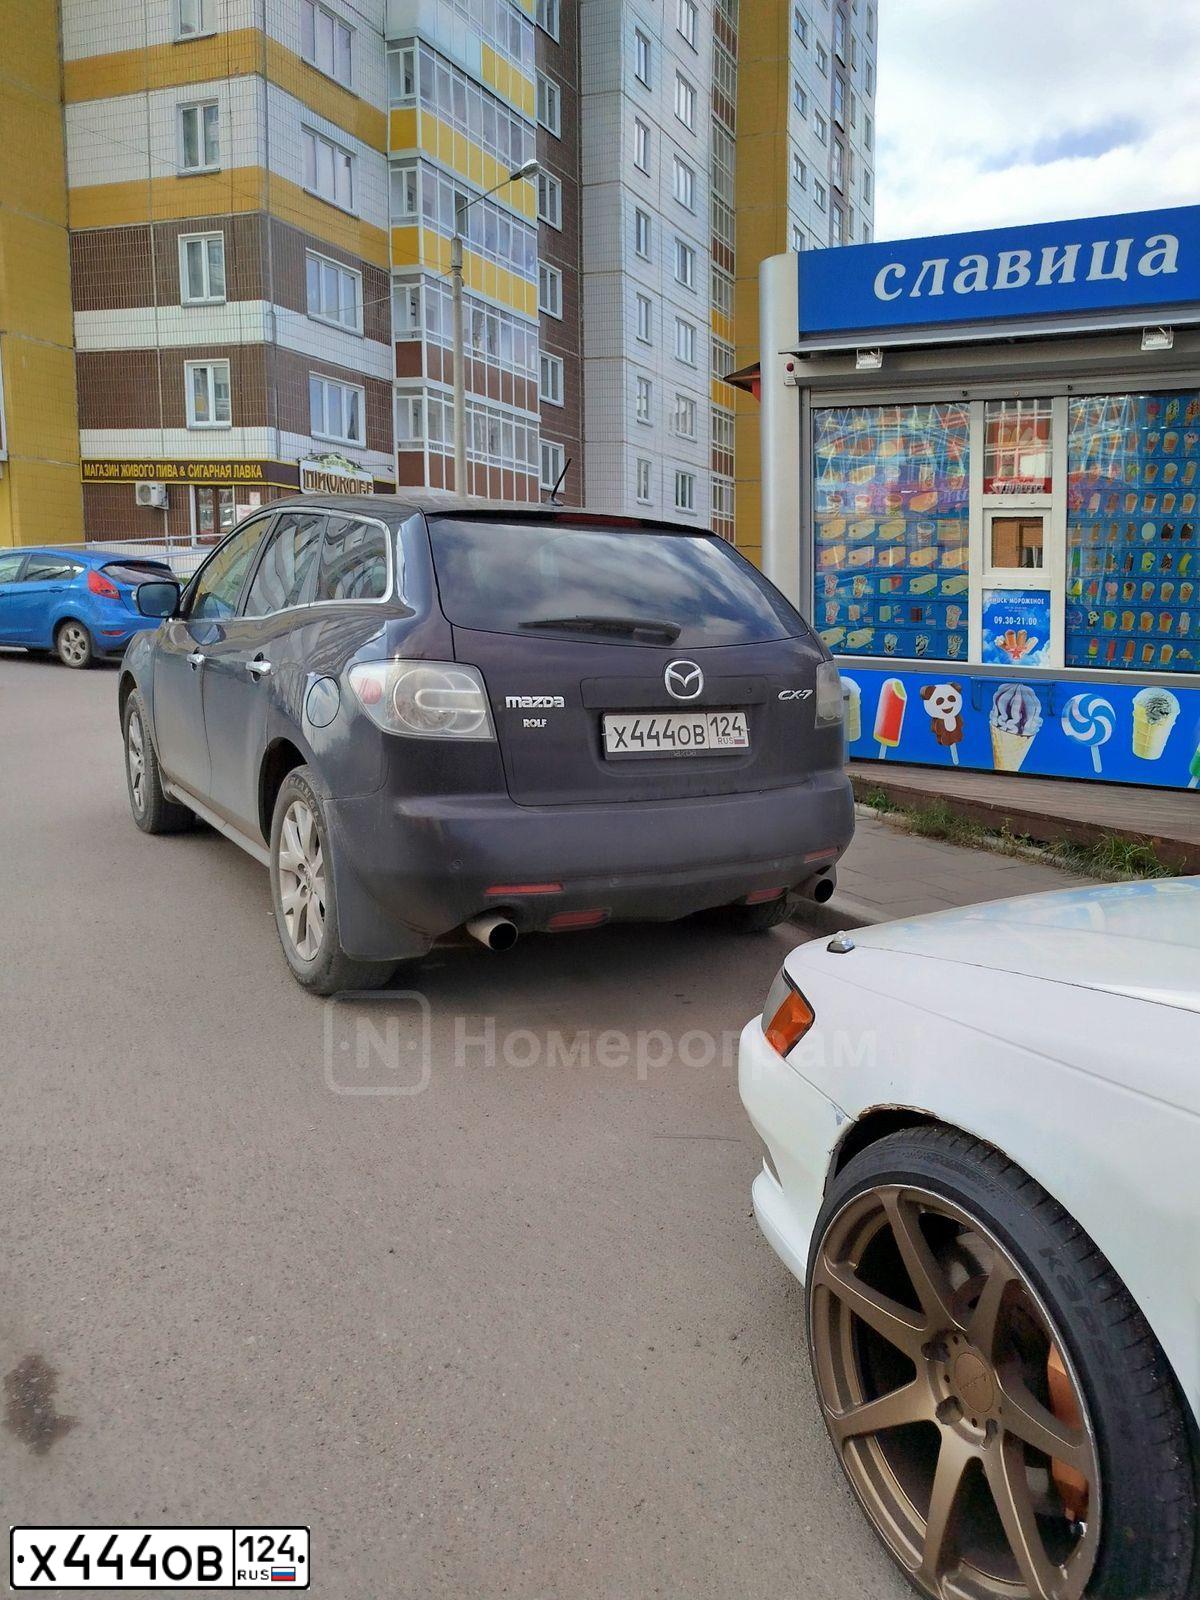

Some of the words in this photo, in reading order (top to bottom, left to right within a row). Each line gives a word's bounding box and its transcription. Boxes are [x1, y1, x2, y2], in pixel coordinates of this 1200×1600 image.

[84, 463, 119, 477] МАГАЗИН
[120, 464, 154, 477] ЖИВОГО
[156, 464, 178, 478] ПИВА
[179, 465, 186, 477] &
[188, 464, 232, 478] СИГАРНАЯ
[233, 464, 262, 479] ЛАВКА
[994, 616, 1038, 626] 09.30-21.00
[778, 689, 814, 702] CX-7
[522, 718, 548, 728] ROLF
[613, 718, 706, 748] Х444ОВ
[710, 716, 744, 737] 124
[718, 736, 734, 744] RUS
